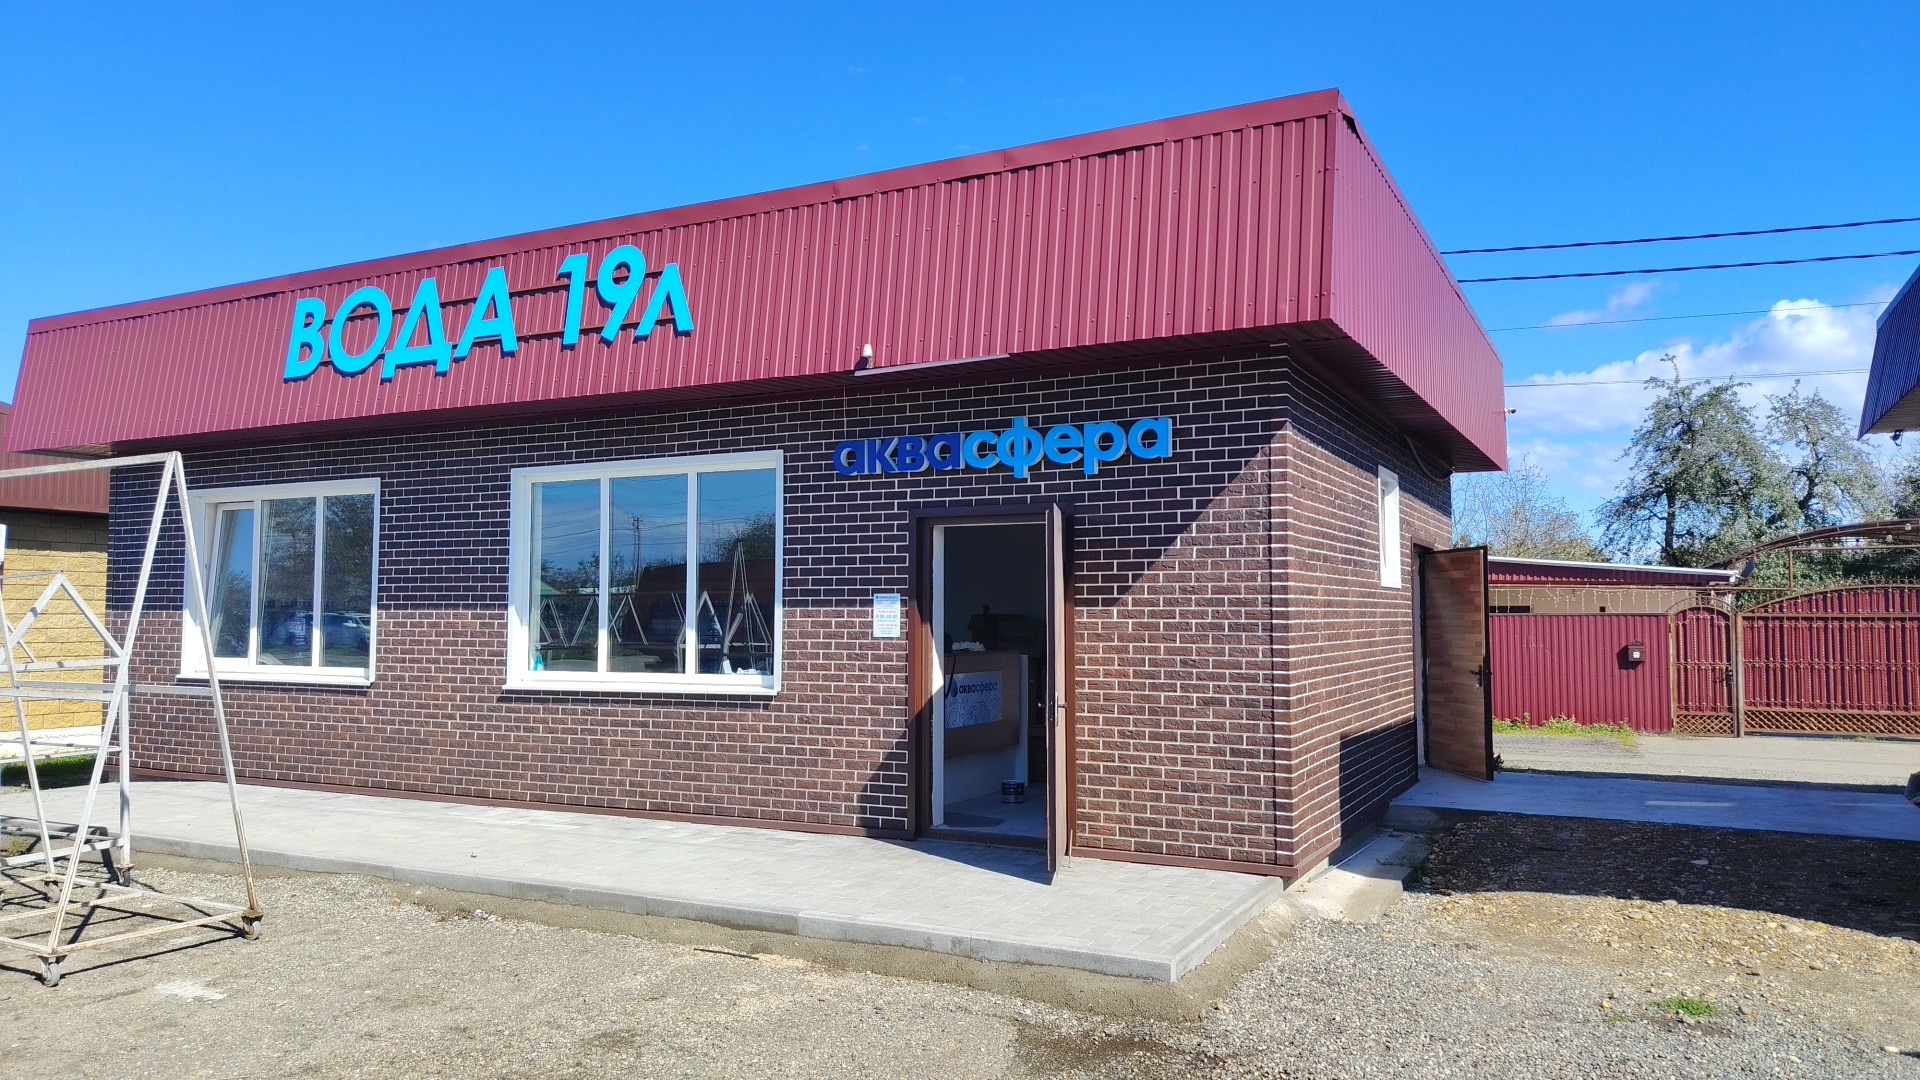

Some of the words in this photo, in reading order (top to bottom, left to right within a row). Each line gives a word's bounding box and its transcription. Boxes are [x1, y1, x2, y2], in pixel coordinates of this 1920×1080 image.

[283, 267, 518, 383] ВОДА
[832, 416, 1173, 479] аквасфера
[958, 681, 998, 694] аквасфера
